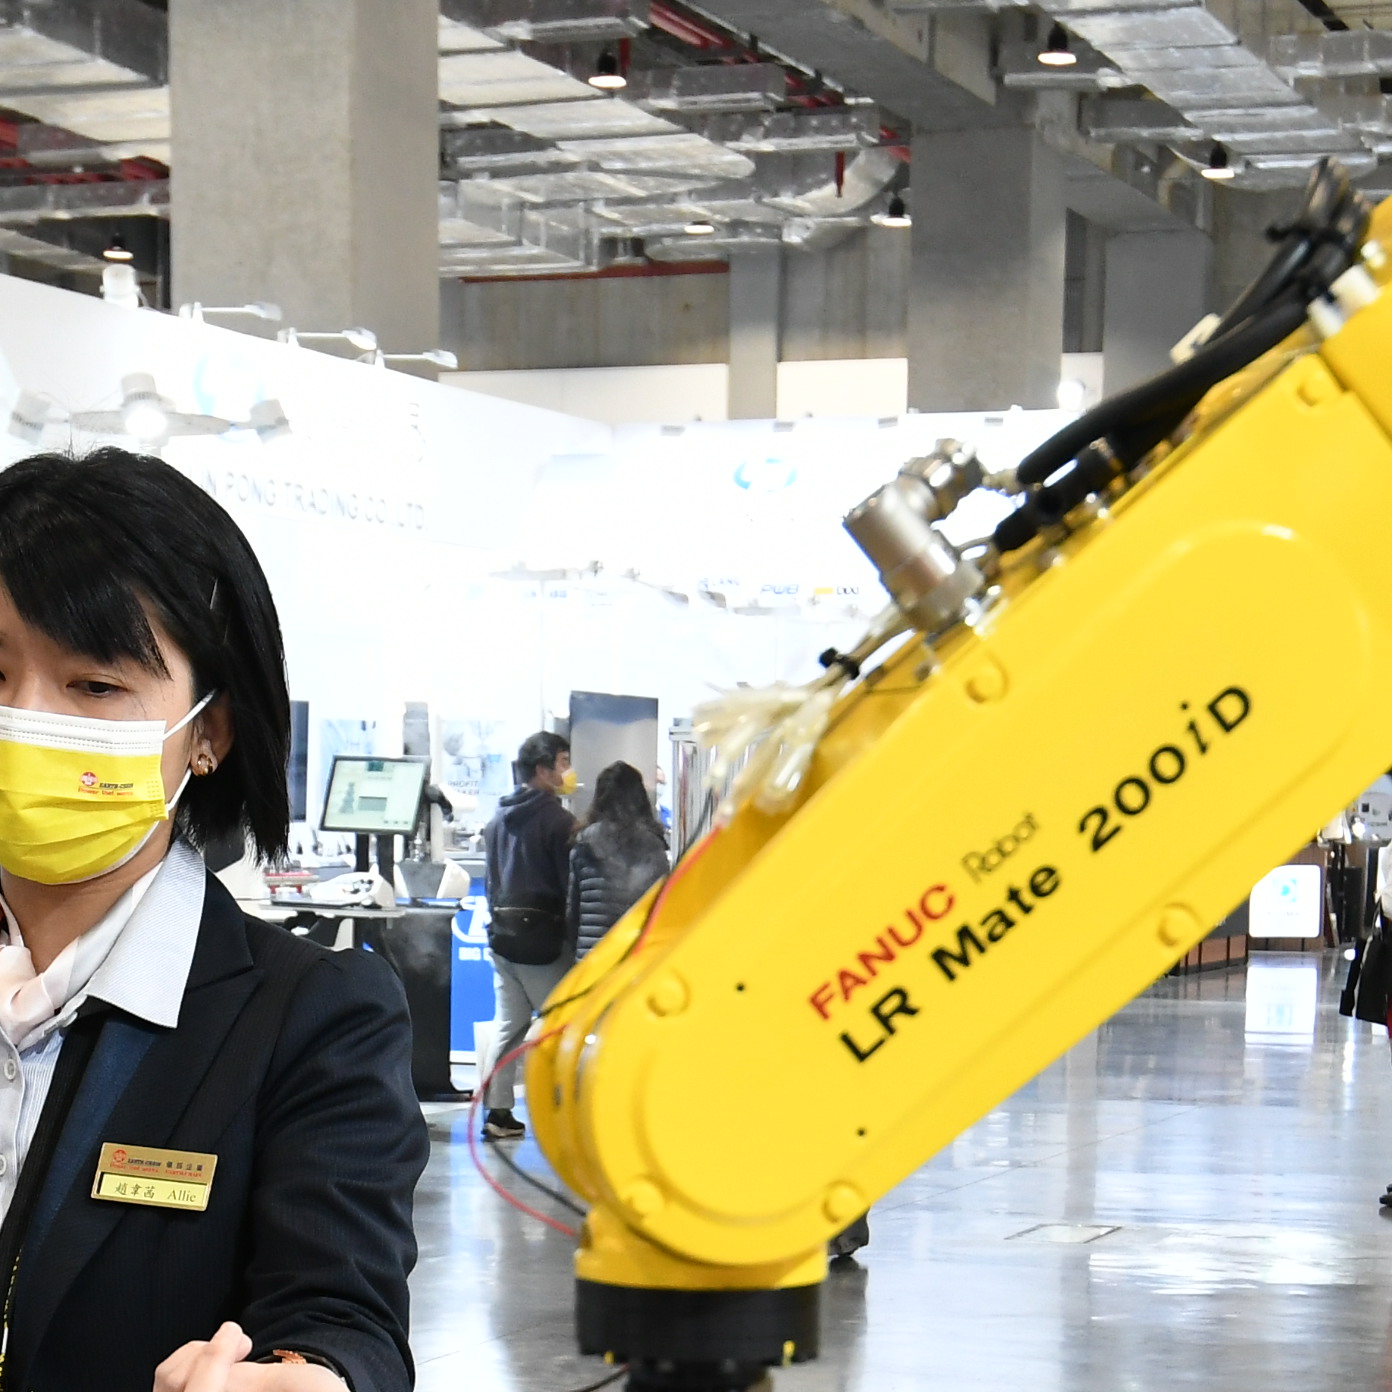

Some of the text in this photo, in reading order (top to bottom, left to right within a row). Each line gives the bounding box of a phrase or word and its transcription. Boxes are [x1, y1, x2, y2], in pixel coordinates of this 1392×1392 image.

[807, 811, 1043, 1021] FANUC Robot
[839, 685, 1251, 1063] LR Mate 200iD
[168, 1189, 197, 1203] Allie
